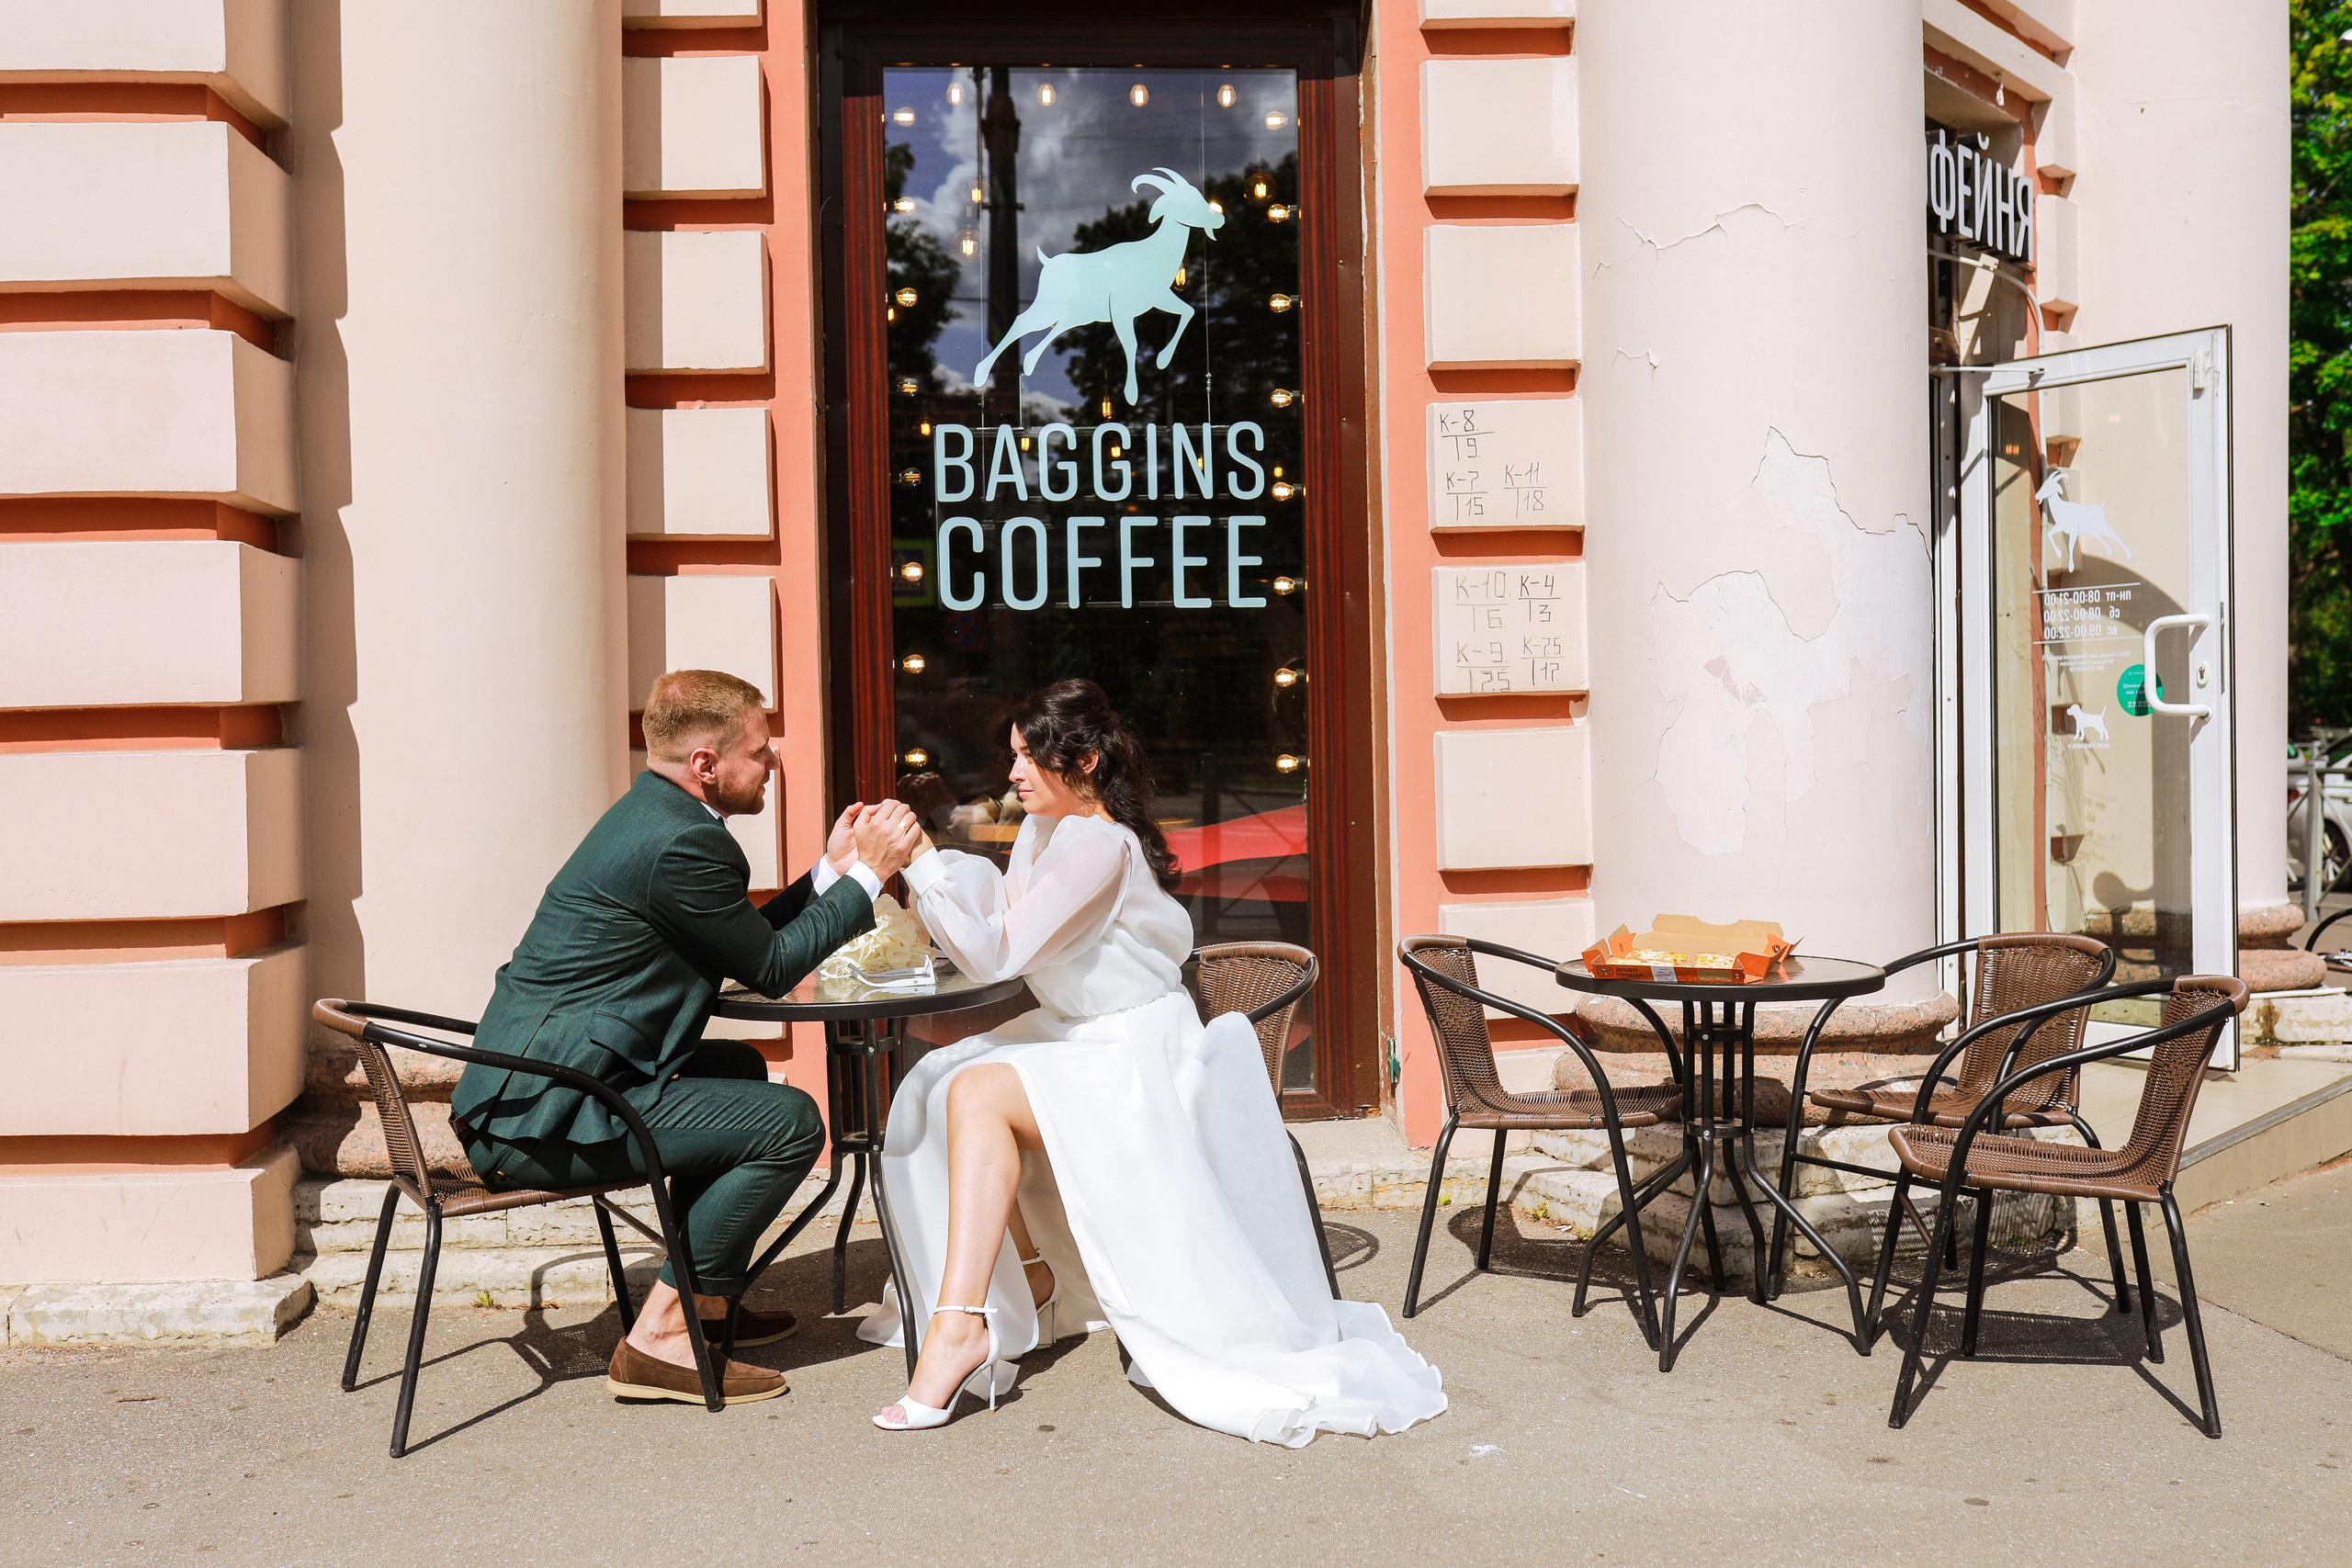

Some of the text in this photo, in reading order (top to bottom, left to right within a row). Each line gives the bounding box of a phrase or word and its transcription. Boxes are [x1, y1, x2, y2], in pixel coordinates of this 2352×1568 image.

[1929, 128, 2034, 263] ФЕЙНЯ
[934, 421, 1265, 502] BAGGINS
[938, 514, 1267, 611] COFFEE
